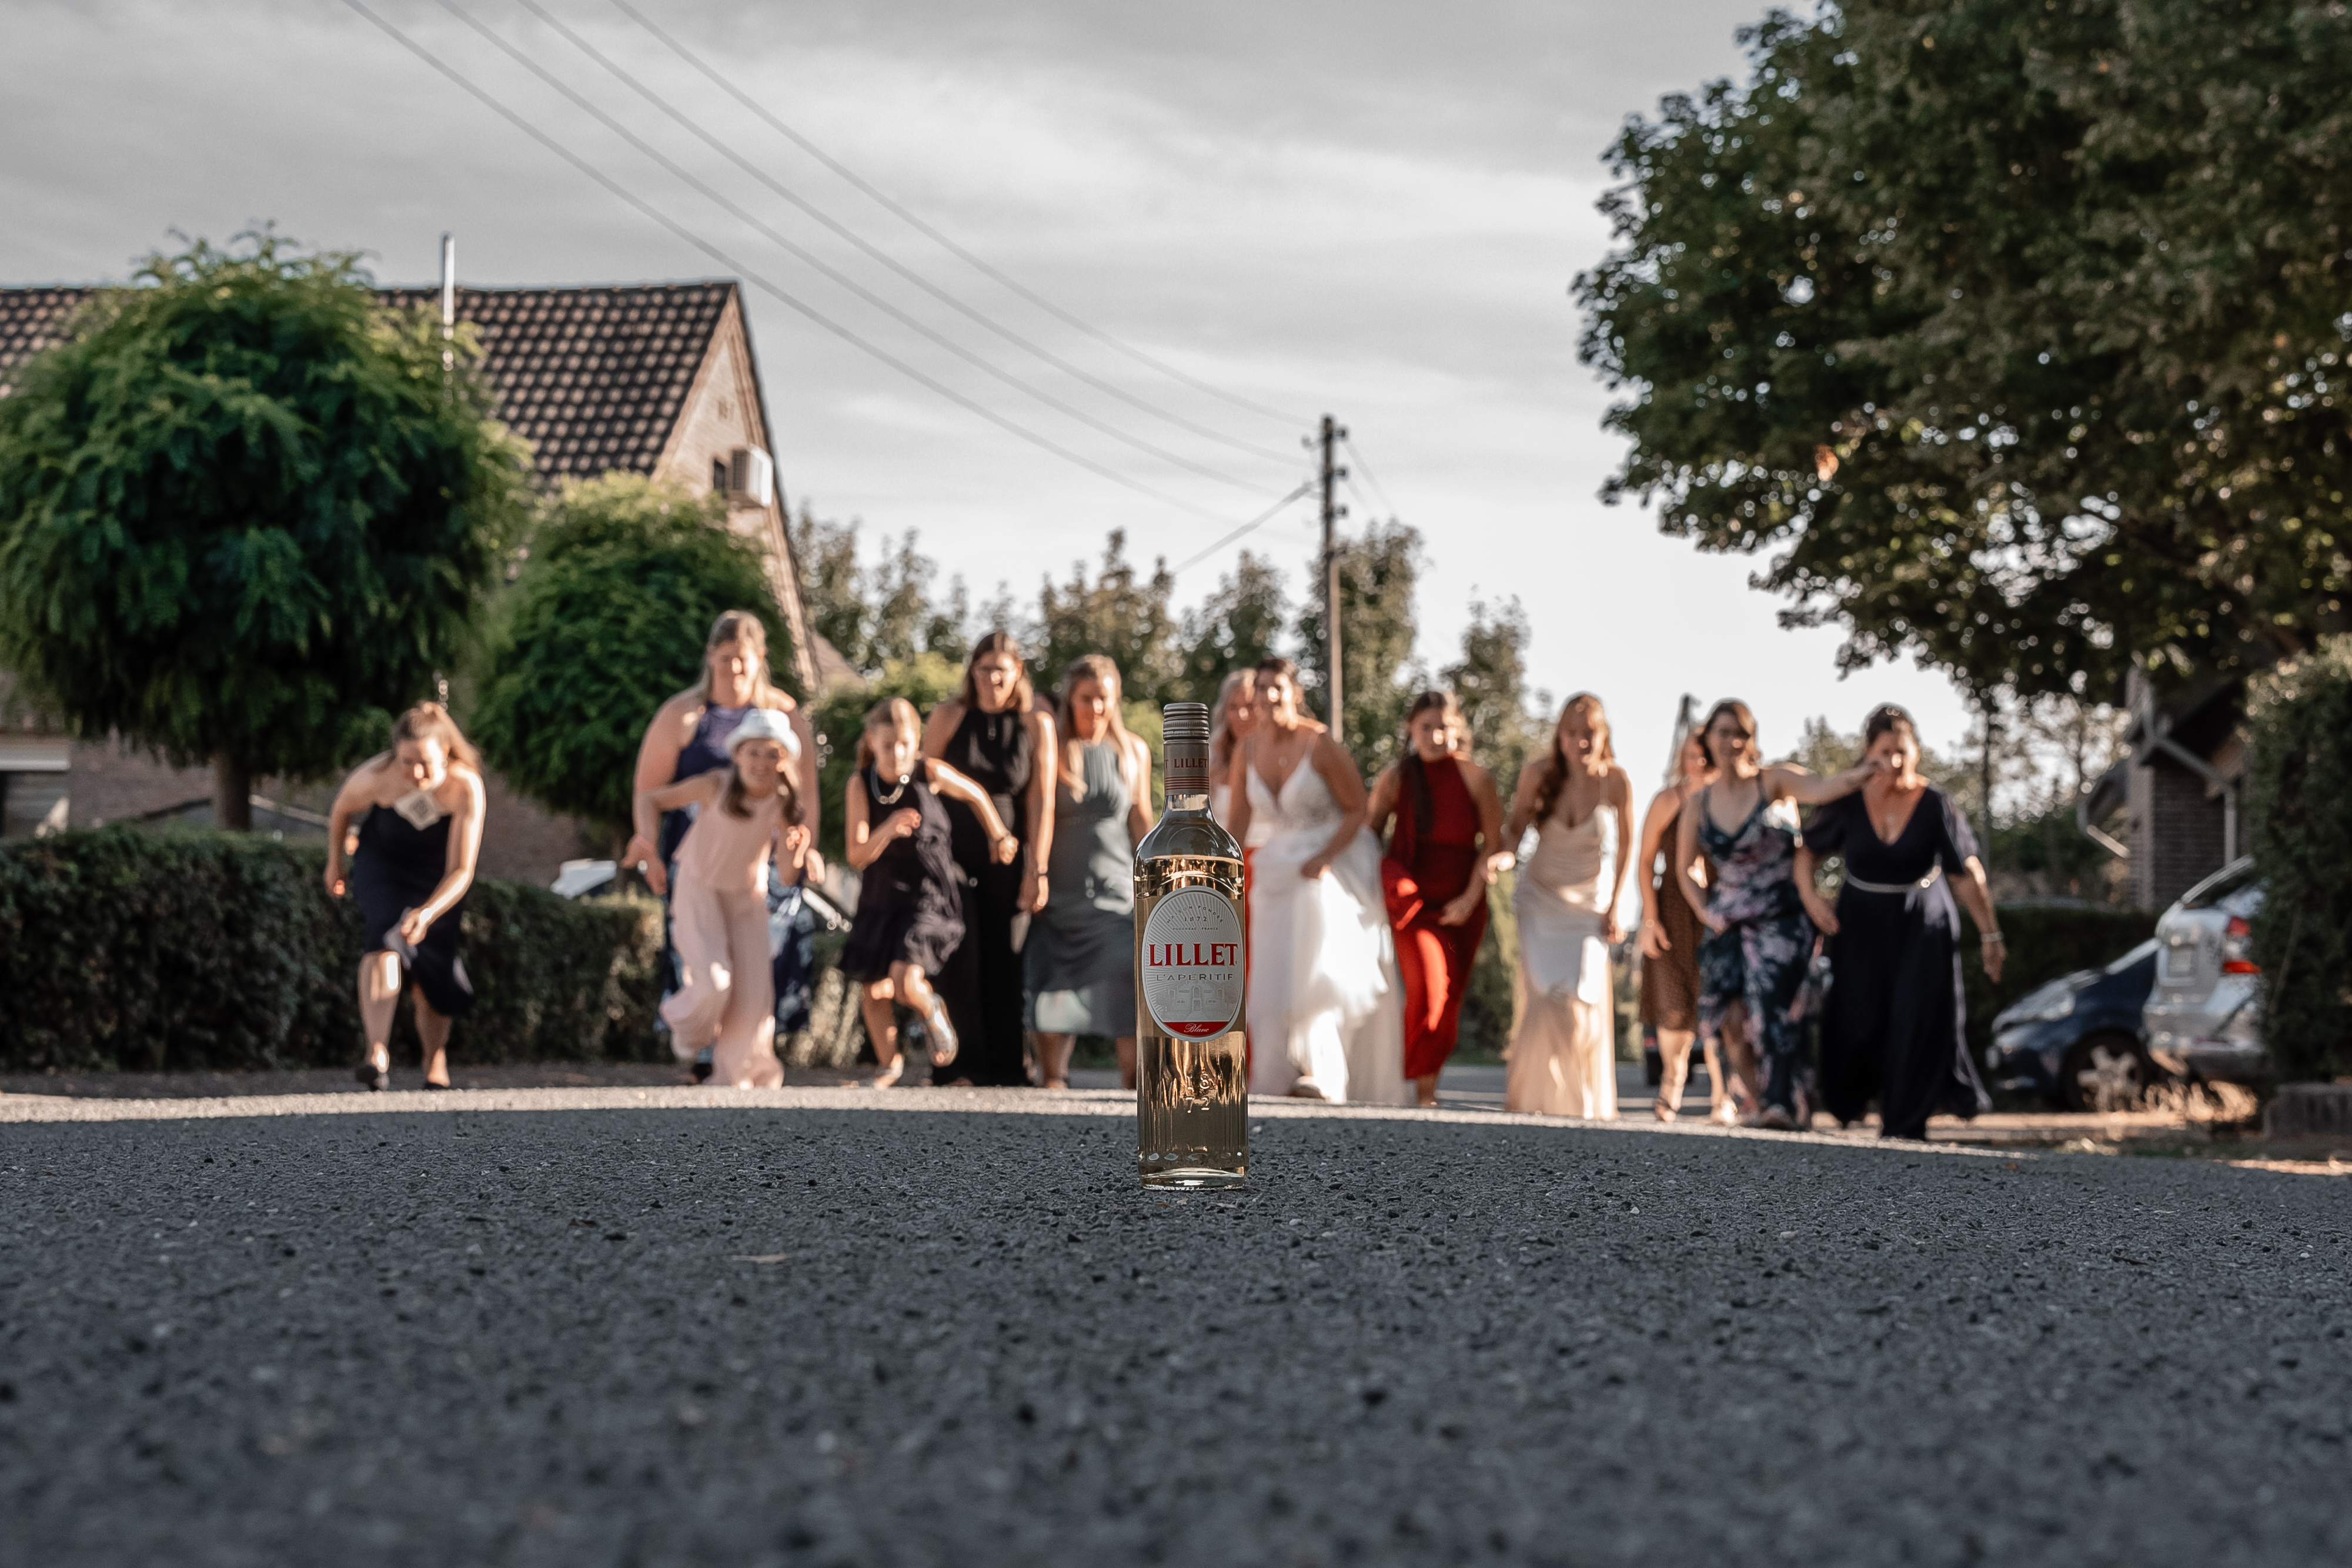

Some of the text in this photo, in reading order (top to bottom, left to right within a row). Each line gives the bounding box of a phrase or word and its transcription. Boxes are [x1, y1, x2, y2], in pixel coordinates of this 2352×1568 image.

[1174, 758, 1208, 768] LILLET
[1167, 905, 1192, 924] MAISON
[1148, 943, 1238, 967] LILLET
[1184, 1024, 1210, 1032] Blanc
